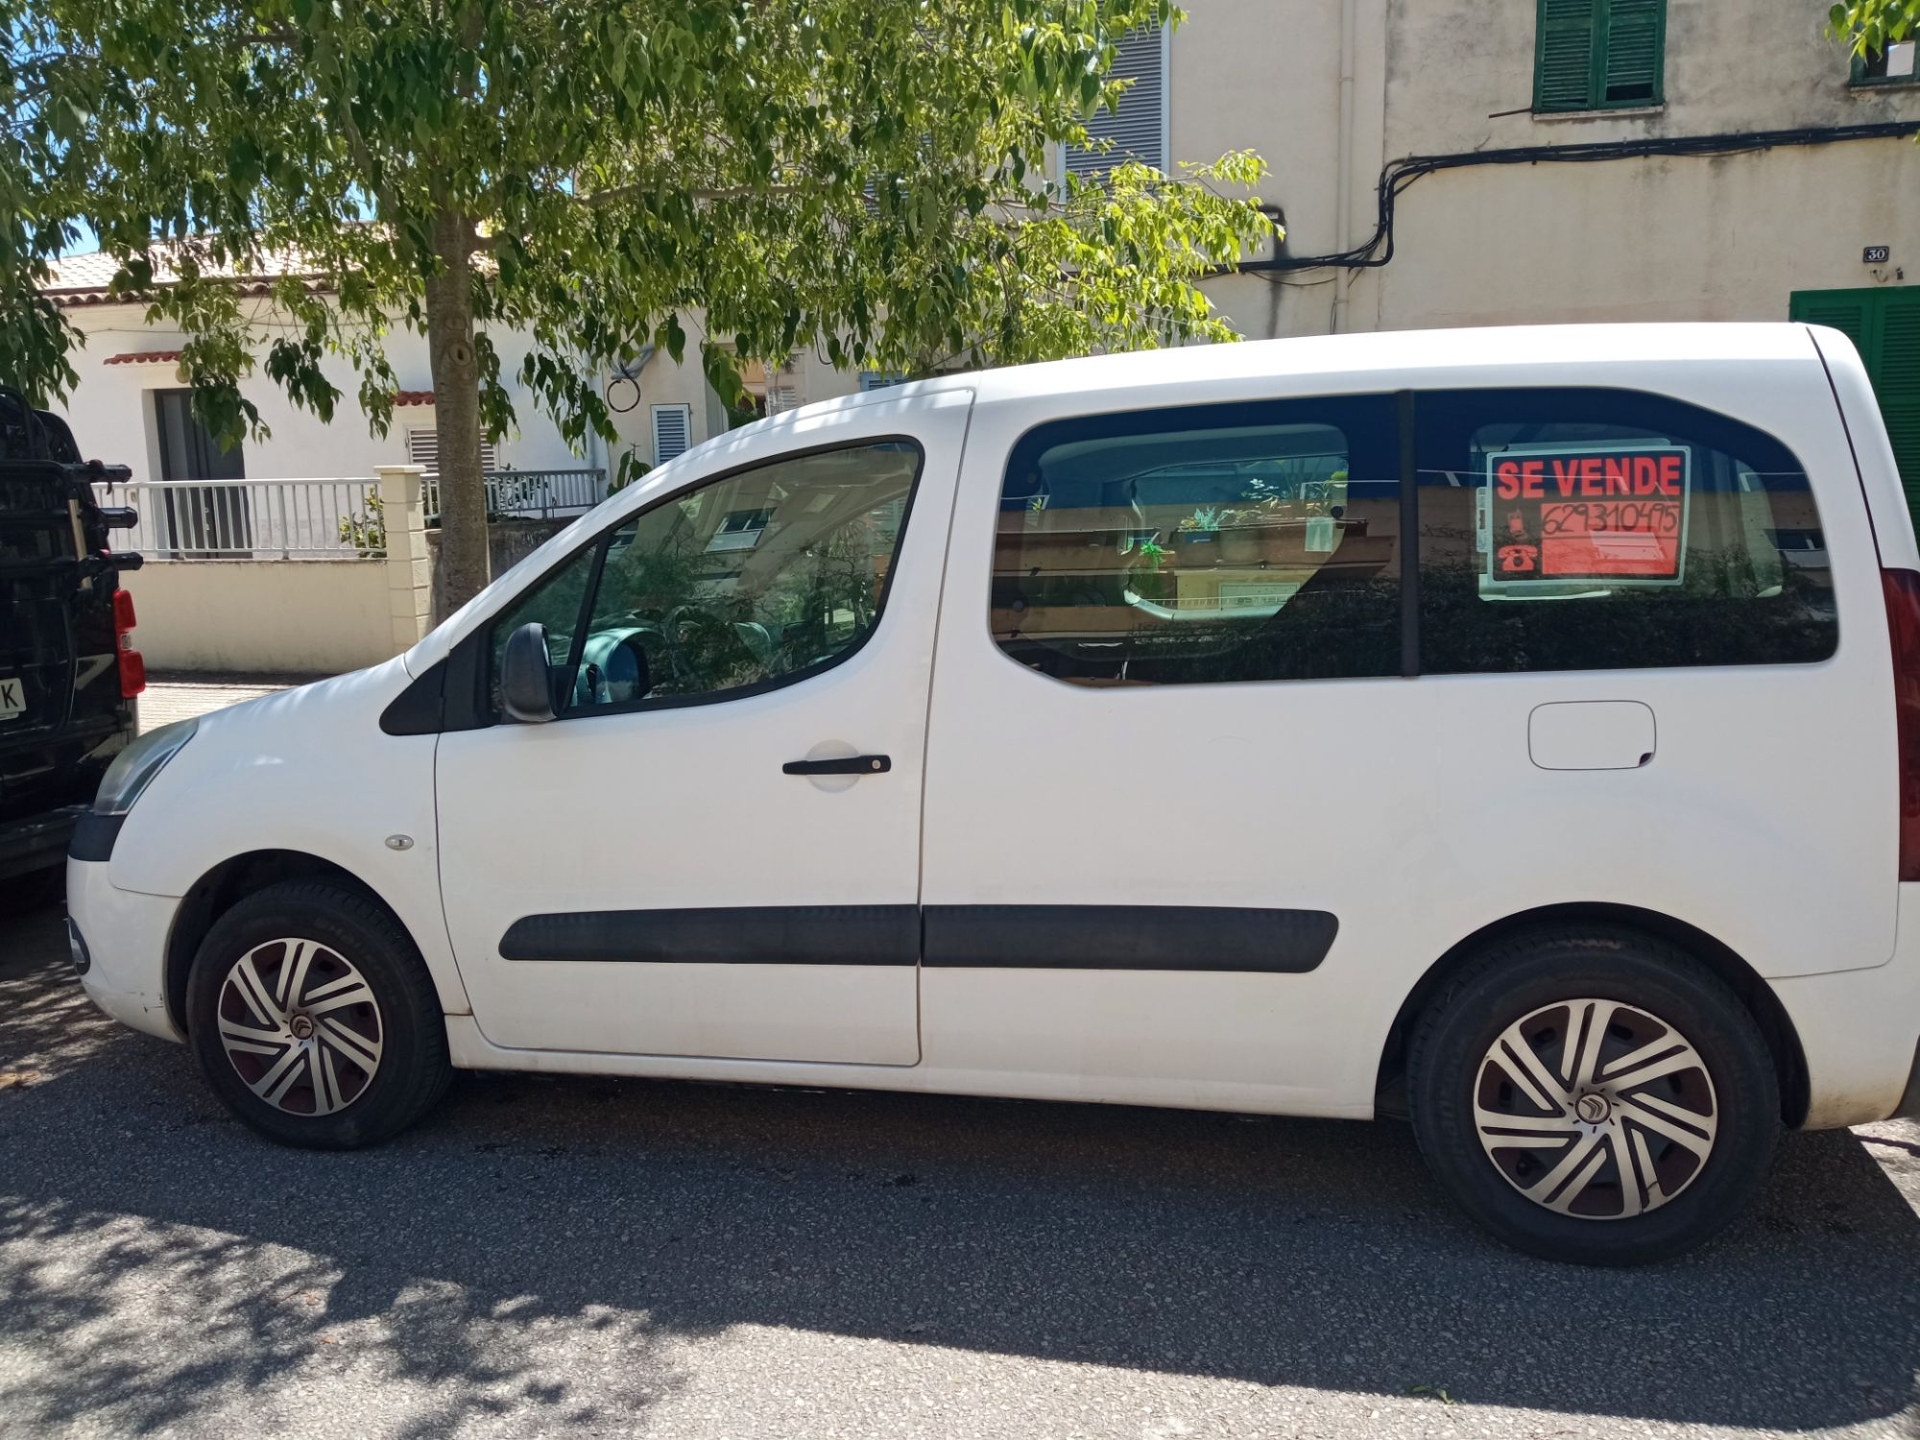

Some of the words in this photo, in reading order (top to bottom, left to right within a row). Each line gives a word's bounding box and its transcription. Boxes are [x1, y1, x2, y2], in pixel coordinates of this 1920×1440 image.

[1868, 249, 1886, 260] 30
[1497, 461, 1544, 499] SE
[1552, 456, 1680, 497] VENDE
[1543, 502, 1680, 535] 629310495
